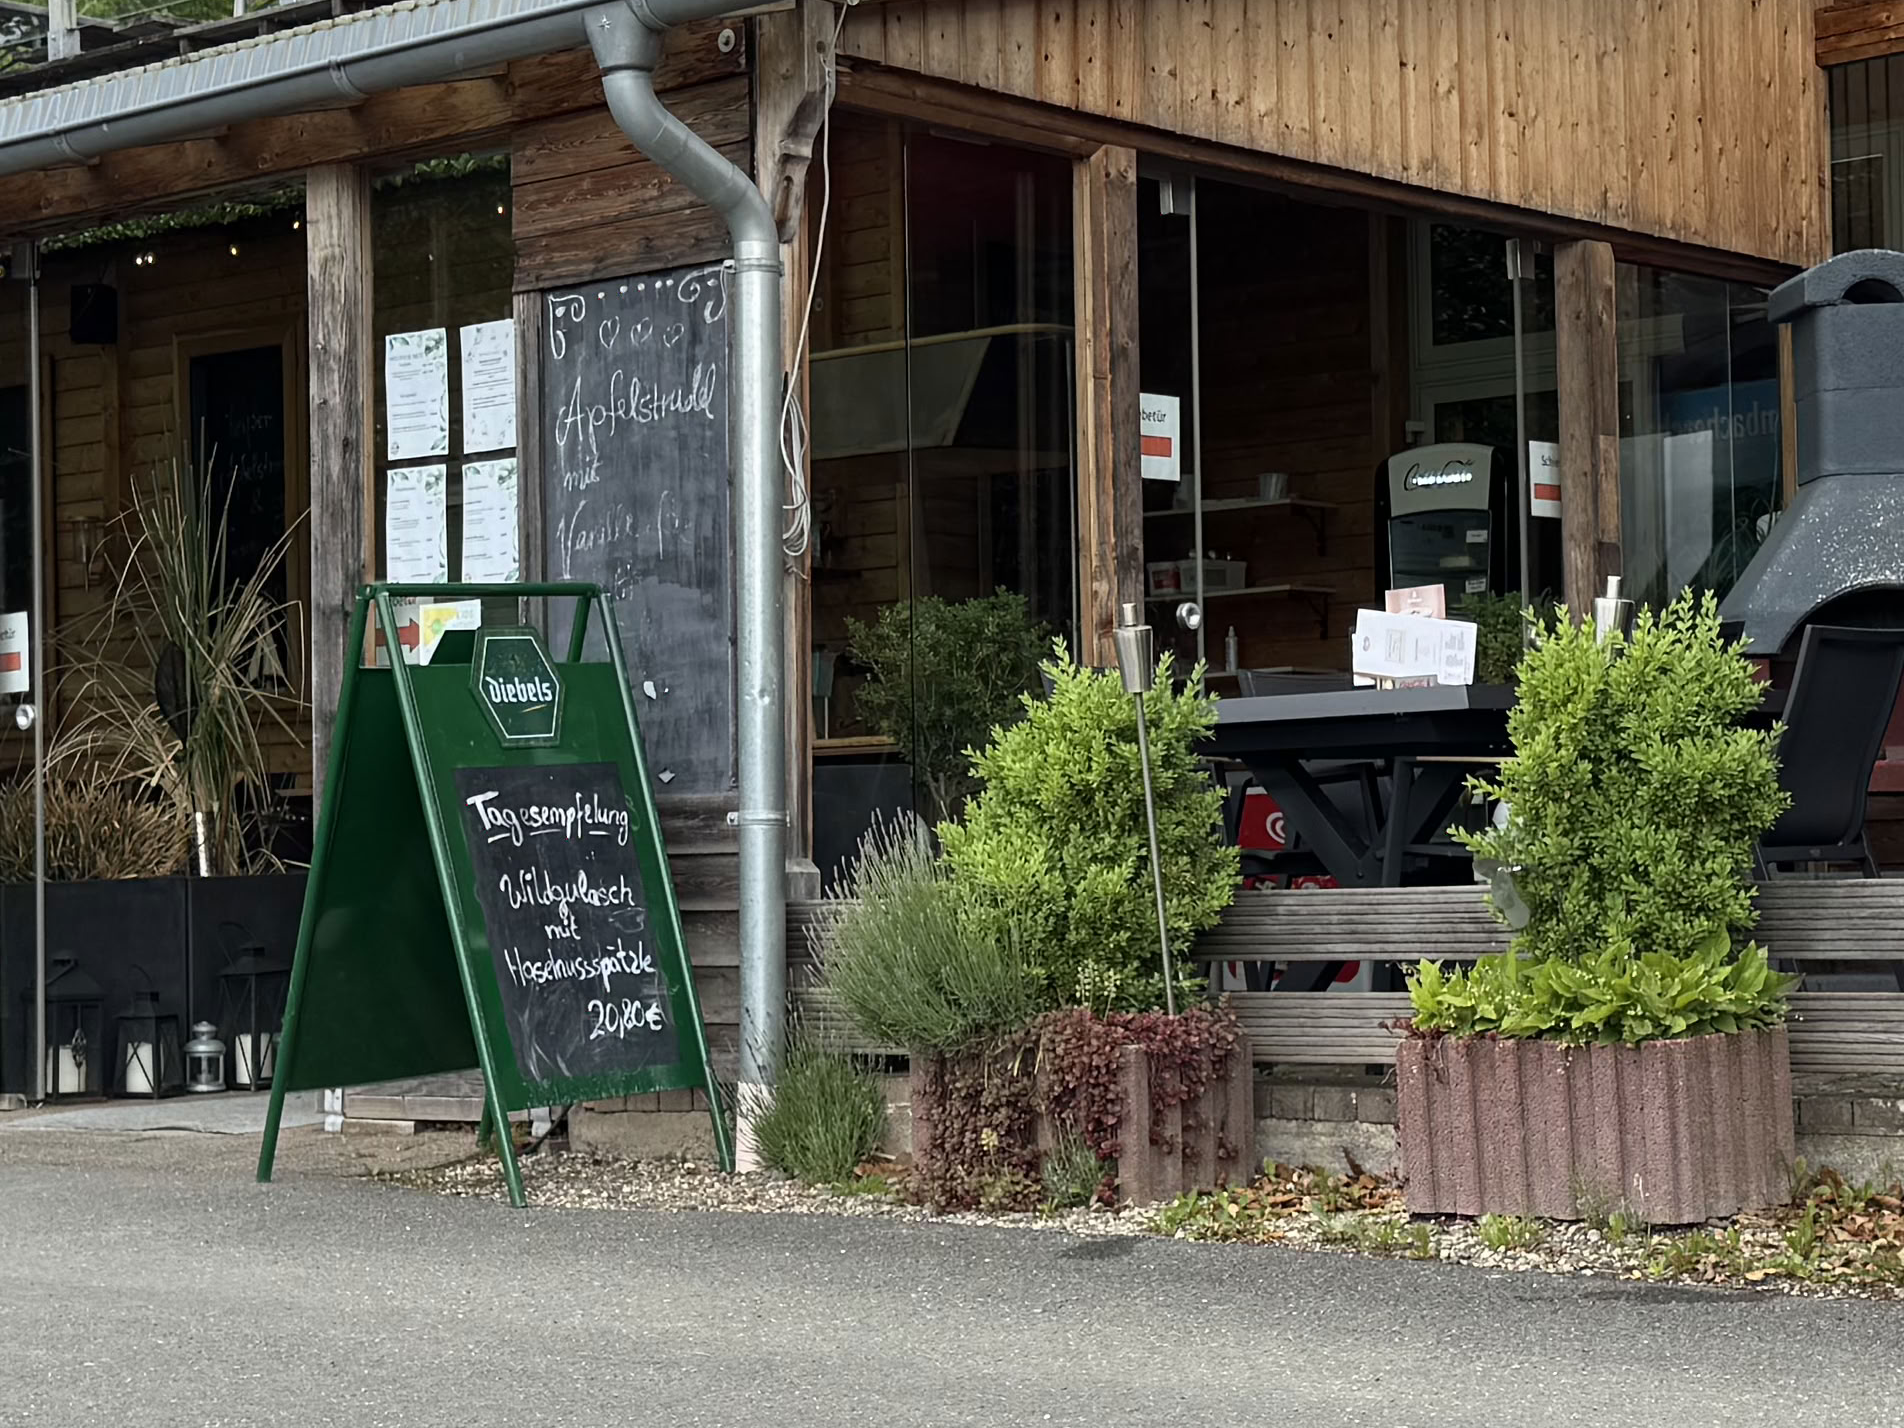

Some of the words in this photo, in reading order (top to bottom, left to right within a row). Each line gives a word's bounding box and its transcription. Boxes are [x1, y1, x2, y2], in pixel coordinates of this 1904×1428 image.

[563, 452, 603, 491] mit
[485, 675, 554, 703] Diebels
[466, 790, 629, 847] Tagesempfelung
[499, 865, 636, 920] Wildgulasch
[544, 914, 581, 941] mit
